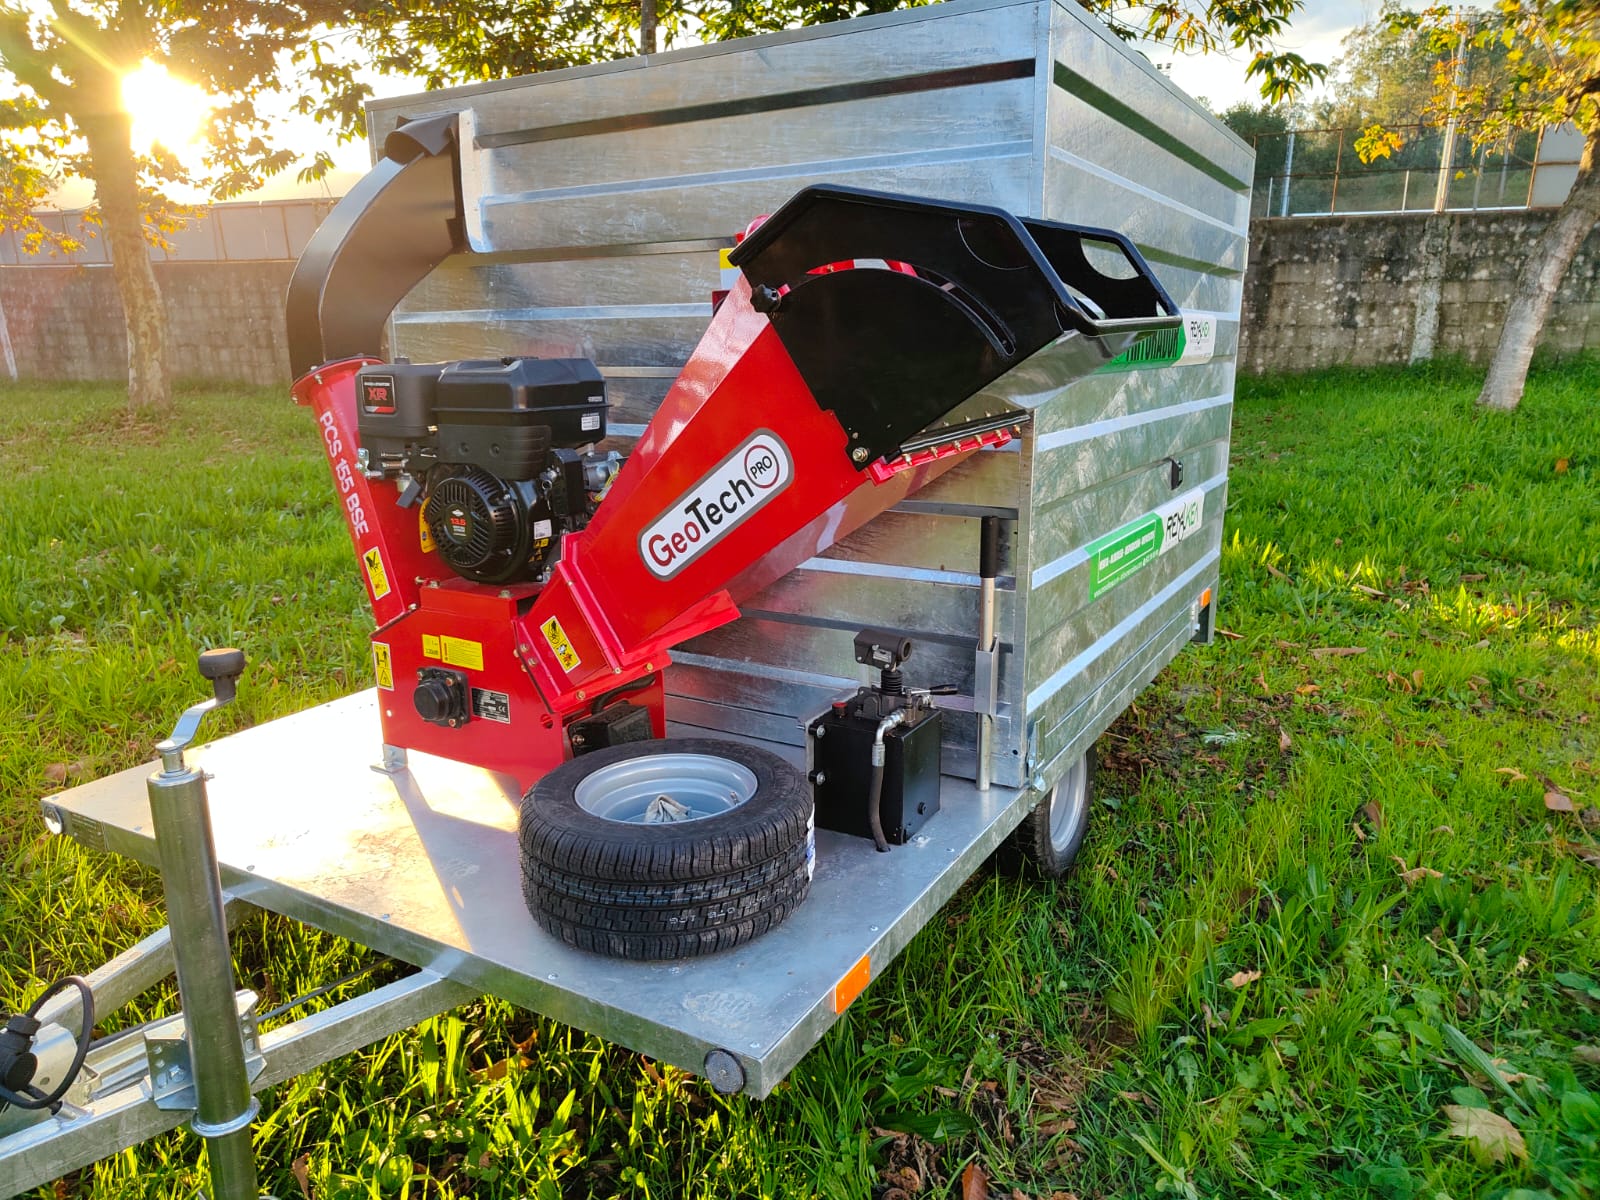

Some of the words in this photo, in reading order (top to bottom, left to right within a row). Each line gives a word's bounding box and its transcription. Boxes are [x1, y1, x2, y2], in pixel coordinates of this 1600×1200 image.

[367, 386, 388, 401] XR
[320, 410, 343, 458] PCS
[335, 457, 355, 493] 155
[346, 493, 369, 539] BSE
[648, 477, 755, 567] GeoTech
[750, 455, 773, 480] PRO
